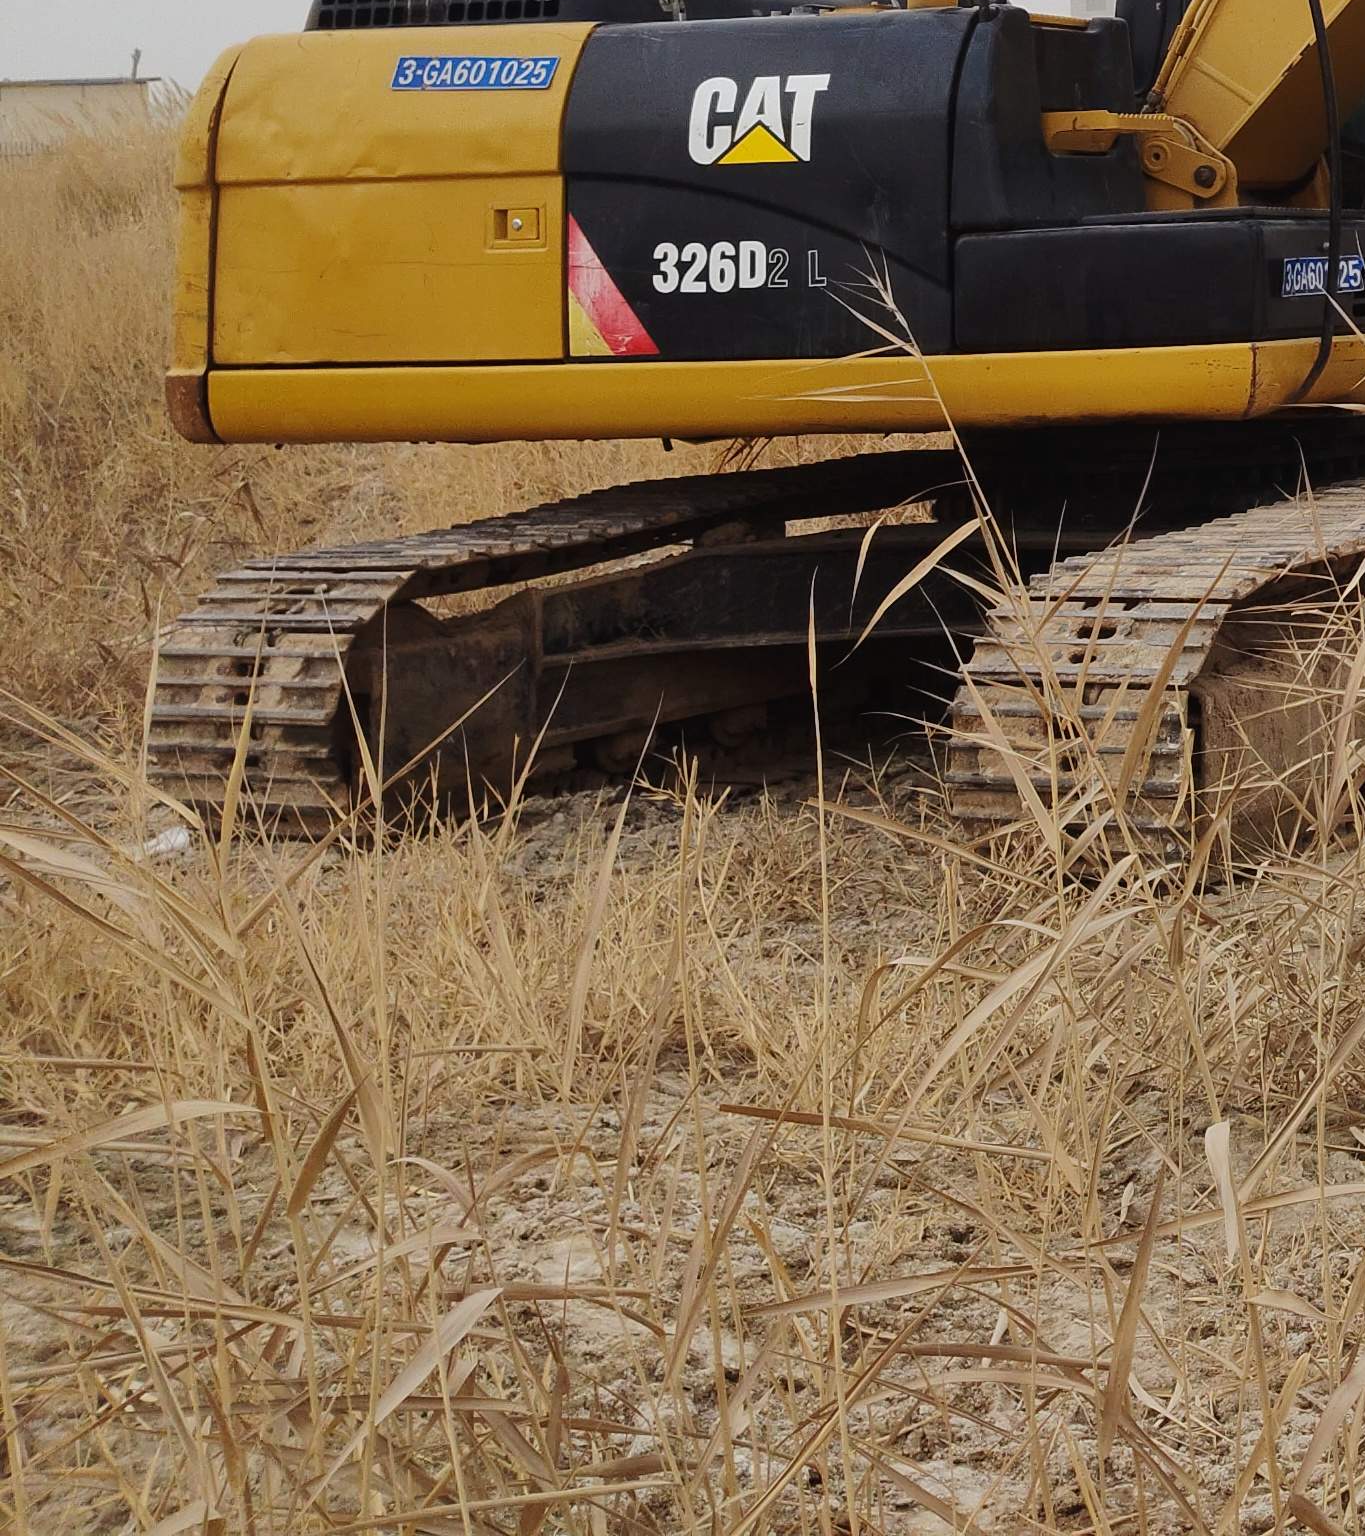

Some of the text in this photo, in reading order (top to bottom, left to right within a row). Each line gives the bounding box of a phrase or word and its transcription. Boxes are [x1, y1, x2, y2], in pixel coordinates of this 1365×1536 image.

[398, 59, 551, 86] 3-GA601025
[688, 73, 831, 165] CAT
[808, 249, 828, 288] L
[1285, 259, 1361, 292] 3-GA6025
